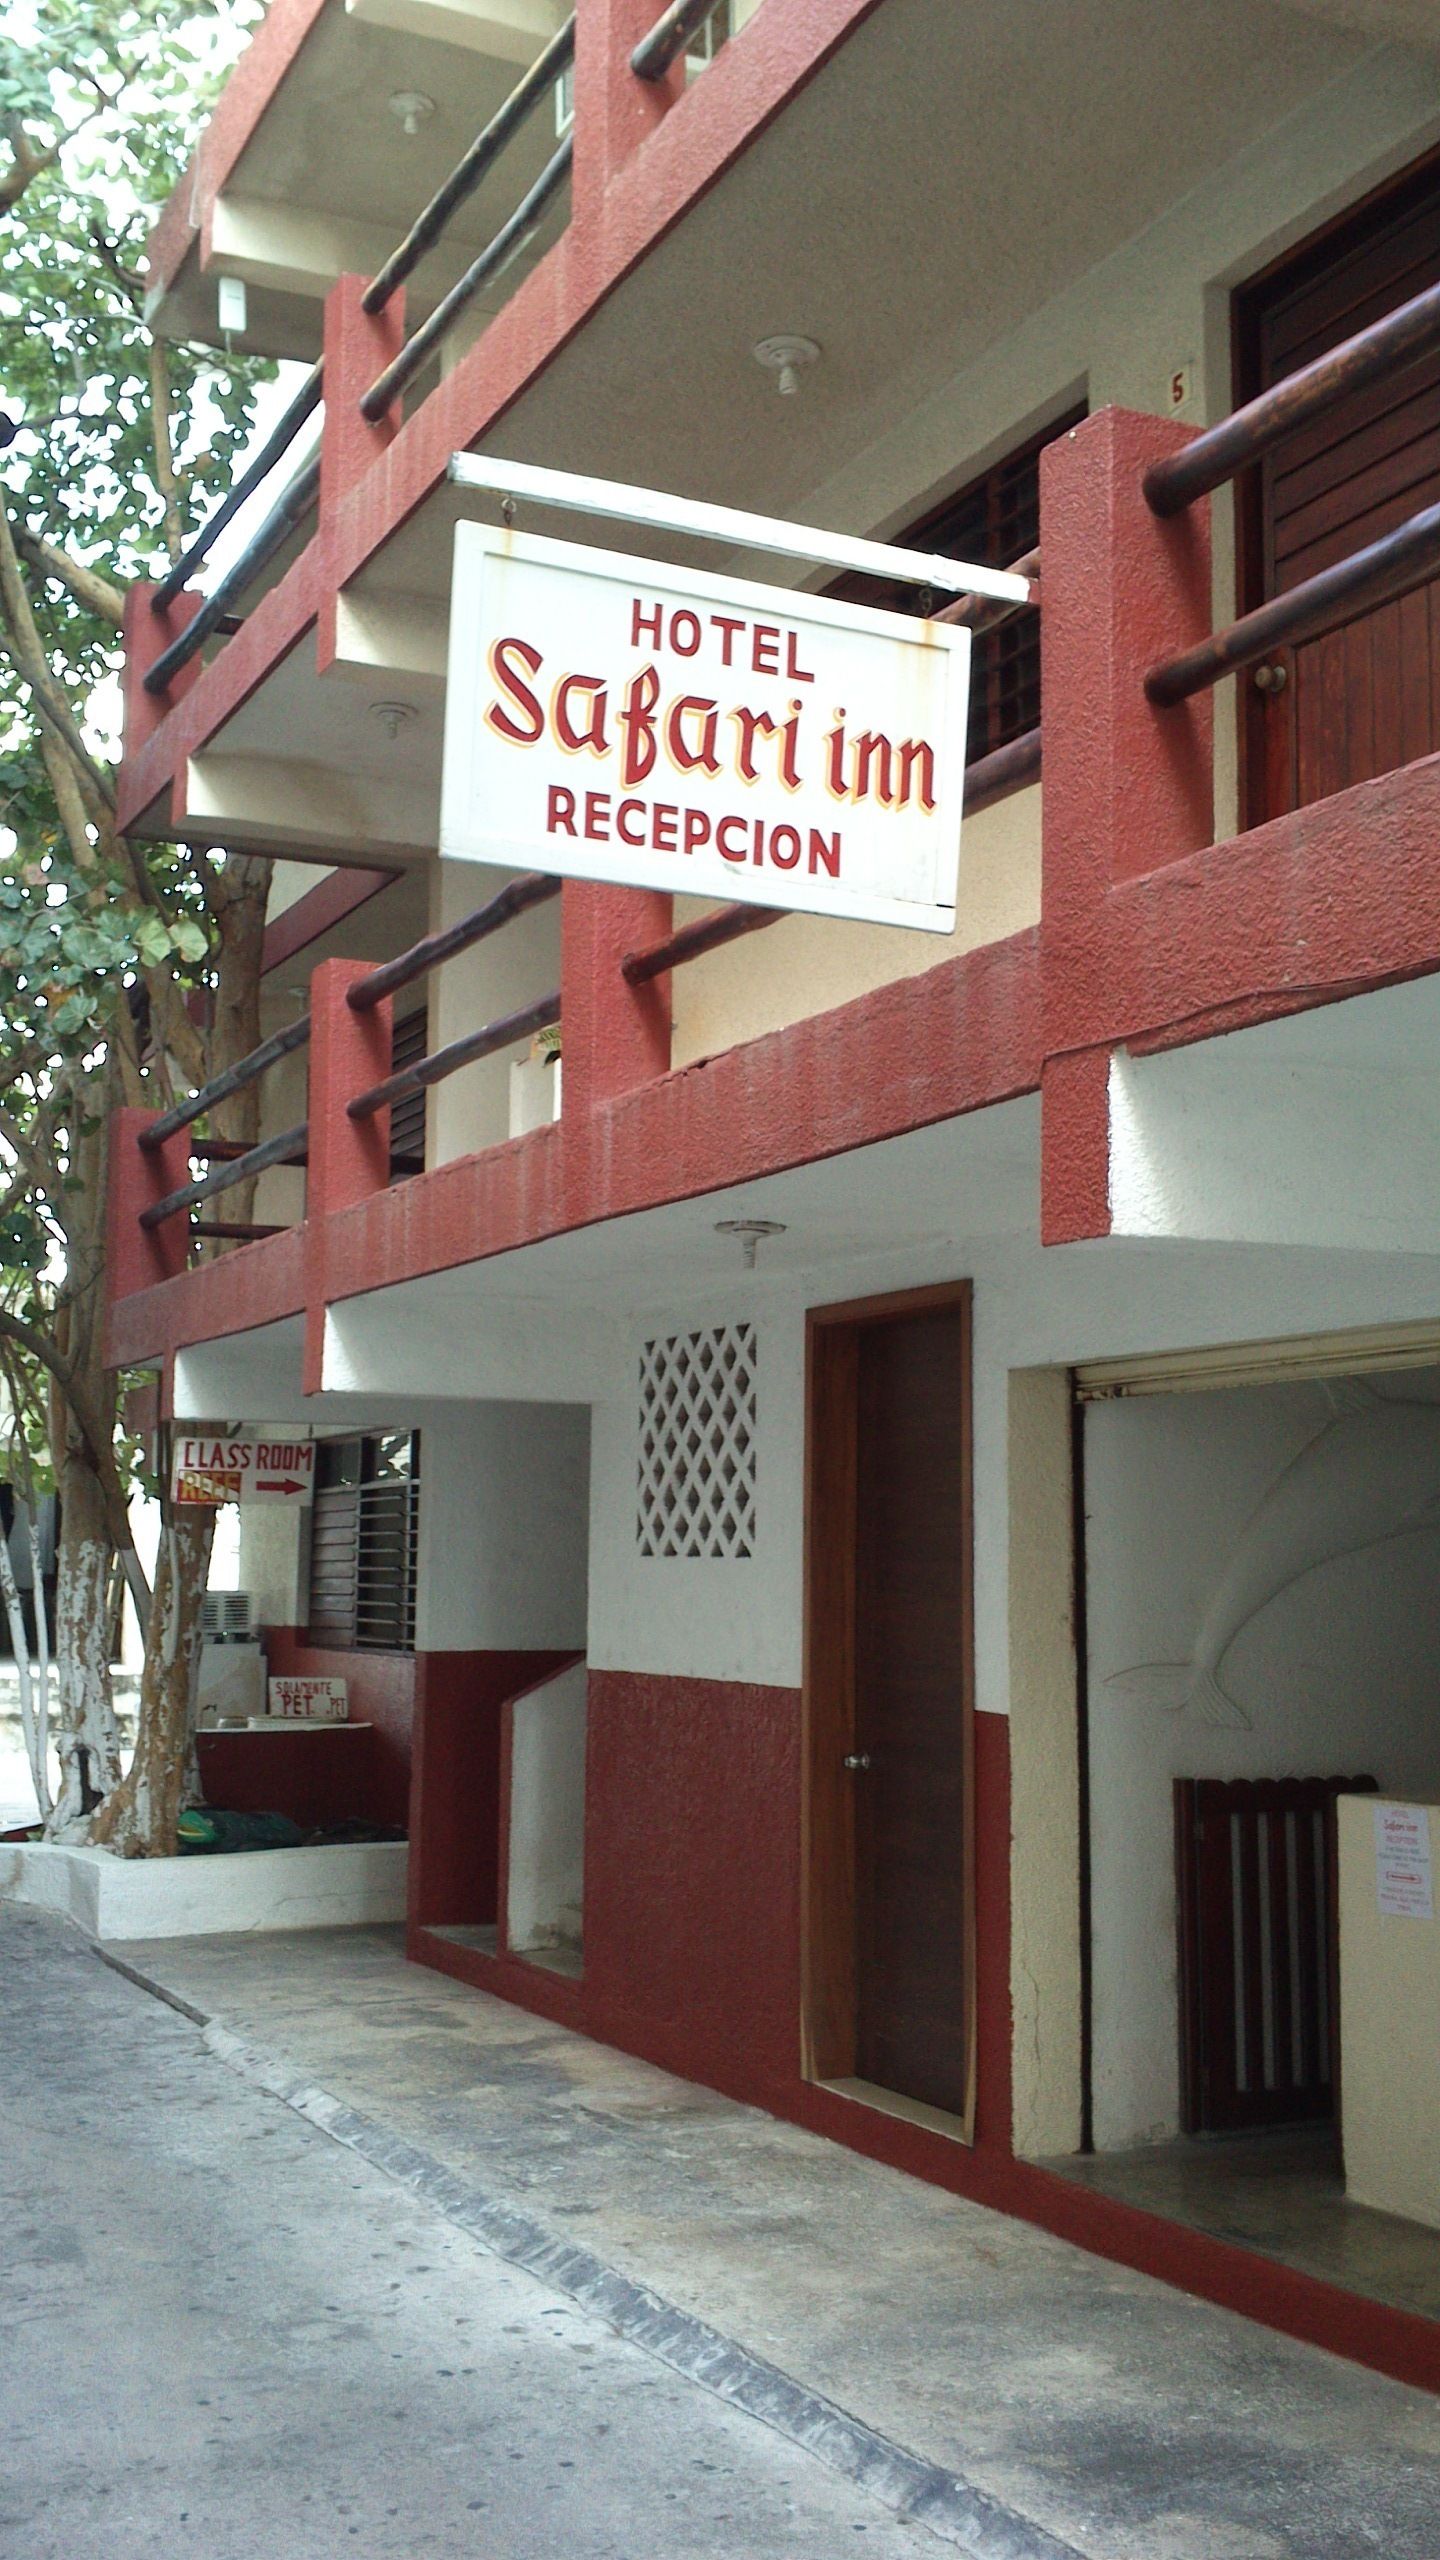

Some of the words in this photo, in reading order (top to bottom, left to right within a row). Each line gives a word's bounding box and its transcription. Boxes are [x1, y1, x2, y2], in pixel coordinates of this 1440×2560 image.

[1172, 371, 1184, 403] 5
[631, 598, 815, 683] HOTEL
[483, 636, 804, 792] Safari
[824, 707, 937, 815] inn
[546, 784, 842, 878] RECEPCION
[184, 1441, 252, 1470] CLASS
[256, 1443, 313, 1472] ROOM
